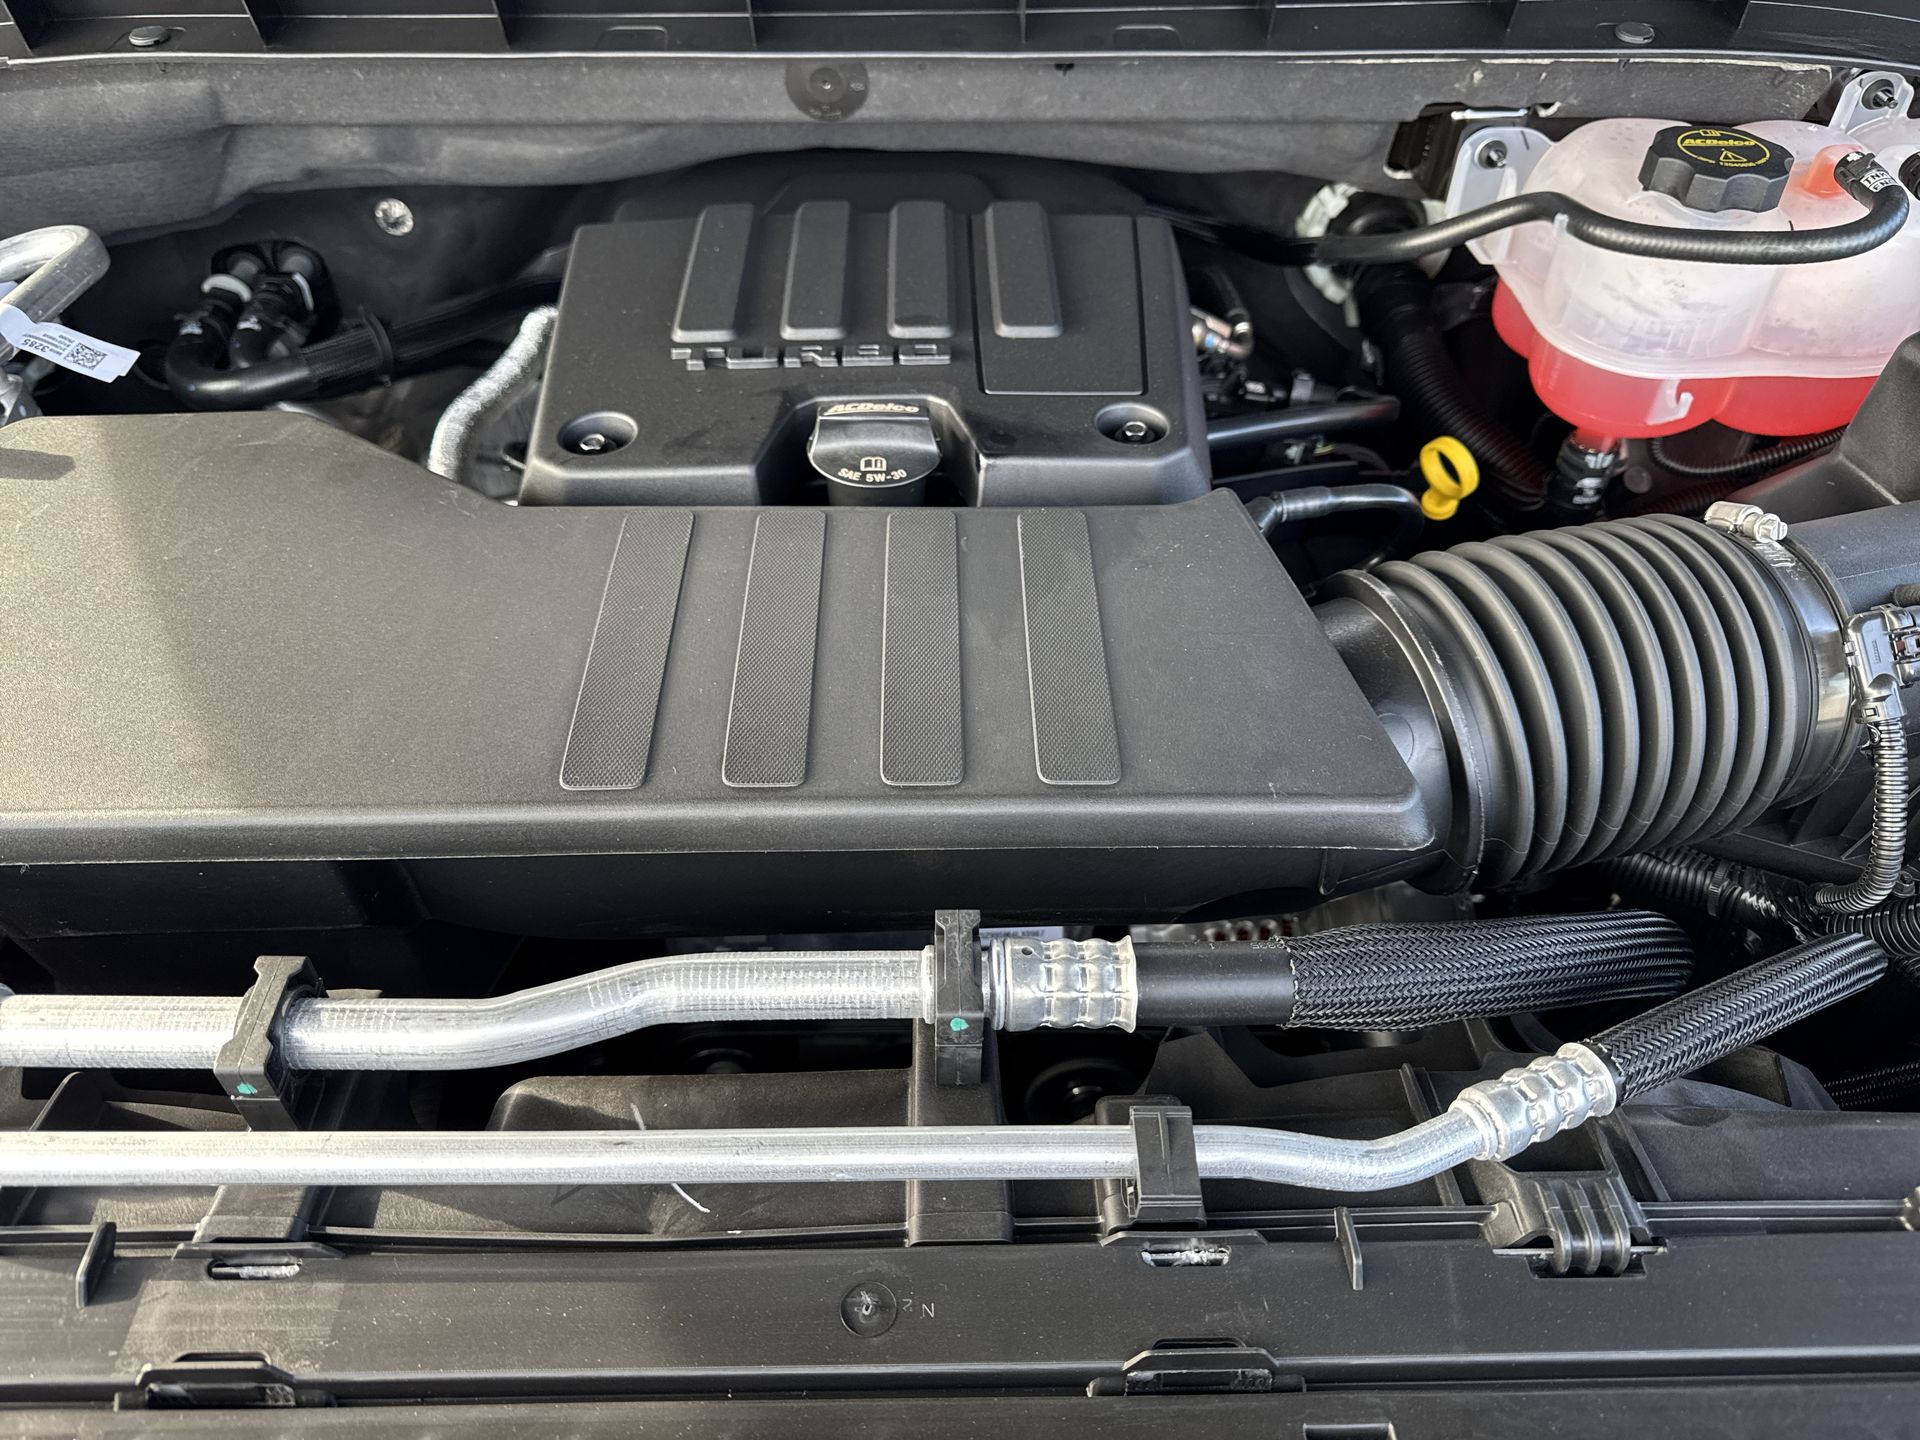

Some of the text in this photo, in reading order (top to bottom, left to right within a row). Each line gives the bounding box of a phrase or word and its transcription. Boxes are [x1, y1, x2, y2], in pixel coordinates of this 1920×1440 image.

[1682, 138, 1757, 147] ACDelco
[22, 338, 50, 353] 3285
[823, 402, 920, 415] ACDelco
[838, 467, 908, 483] SAE 5W-30
